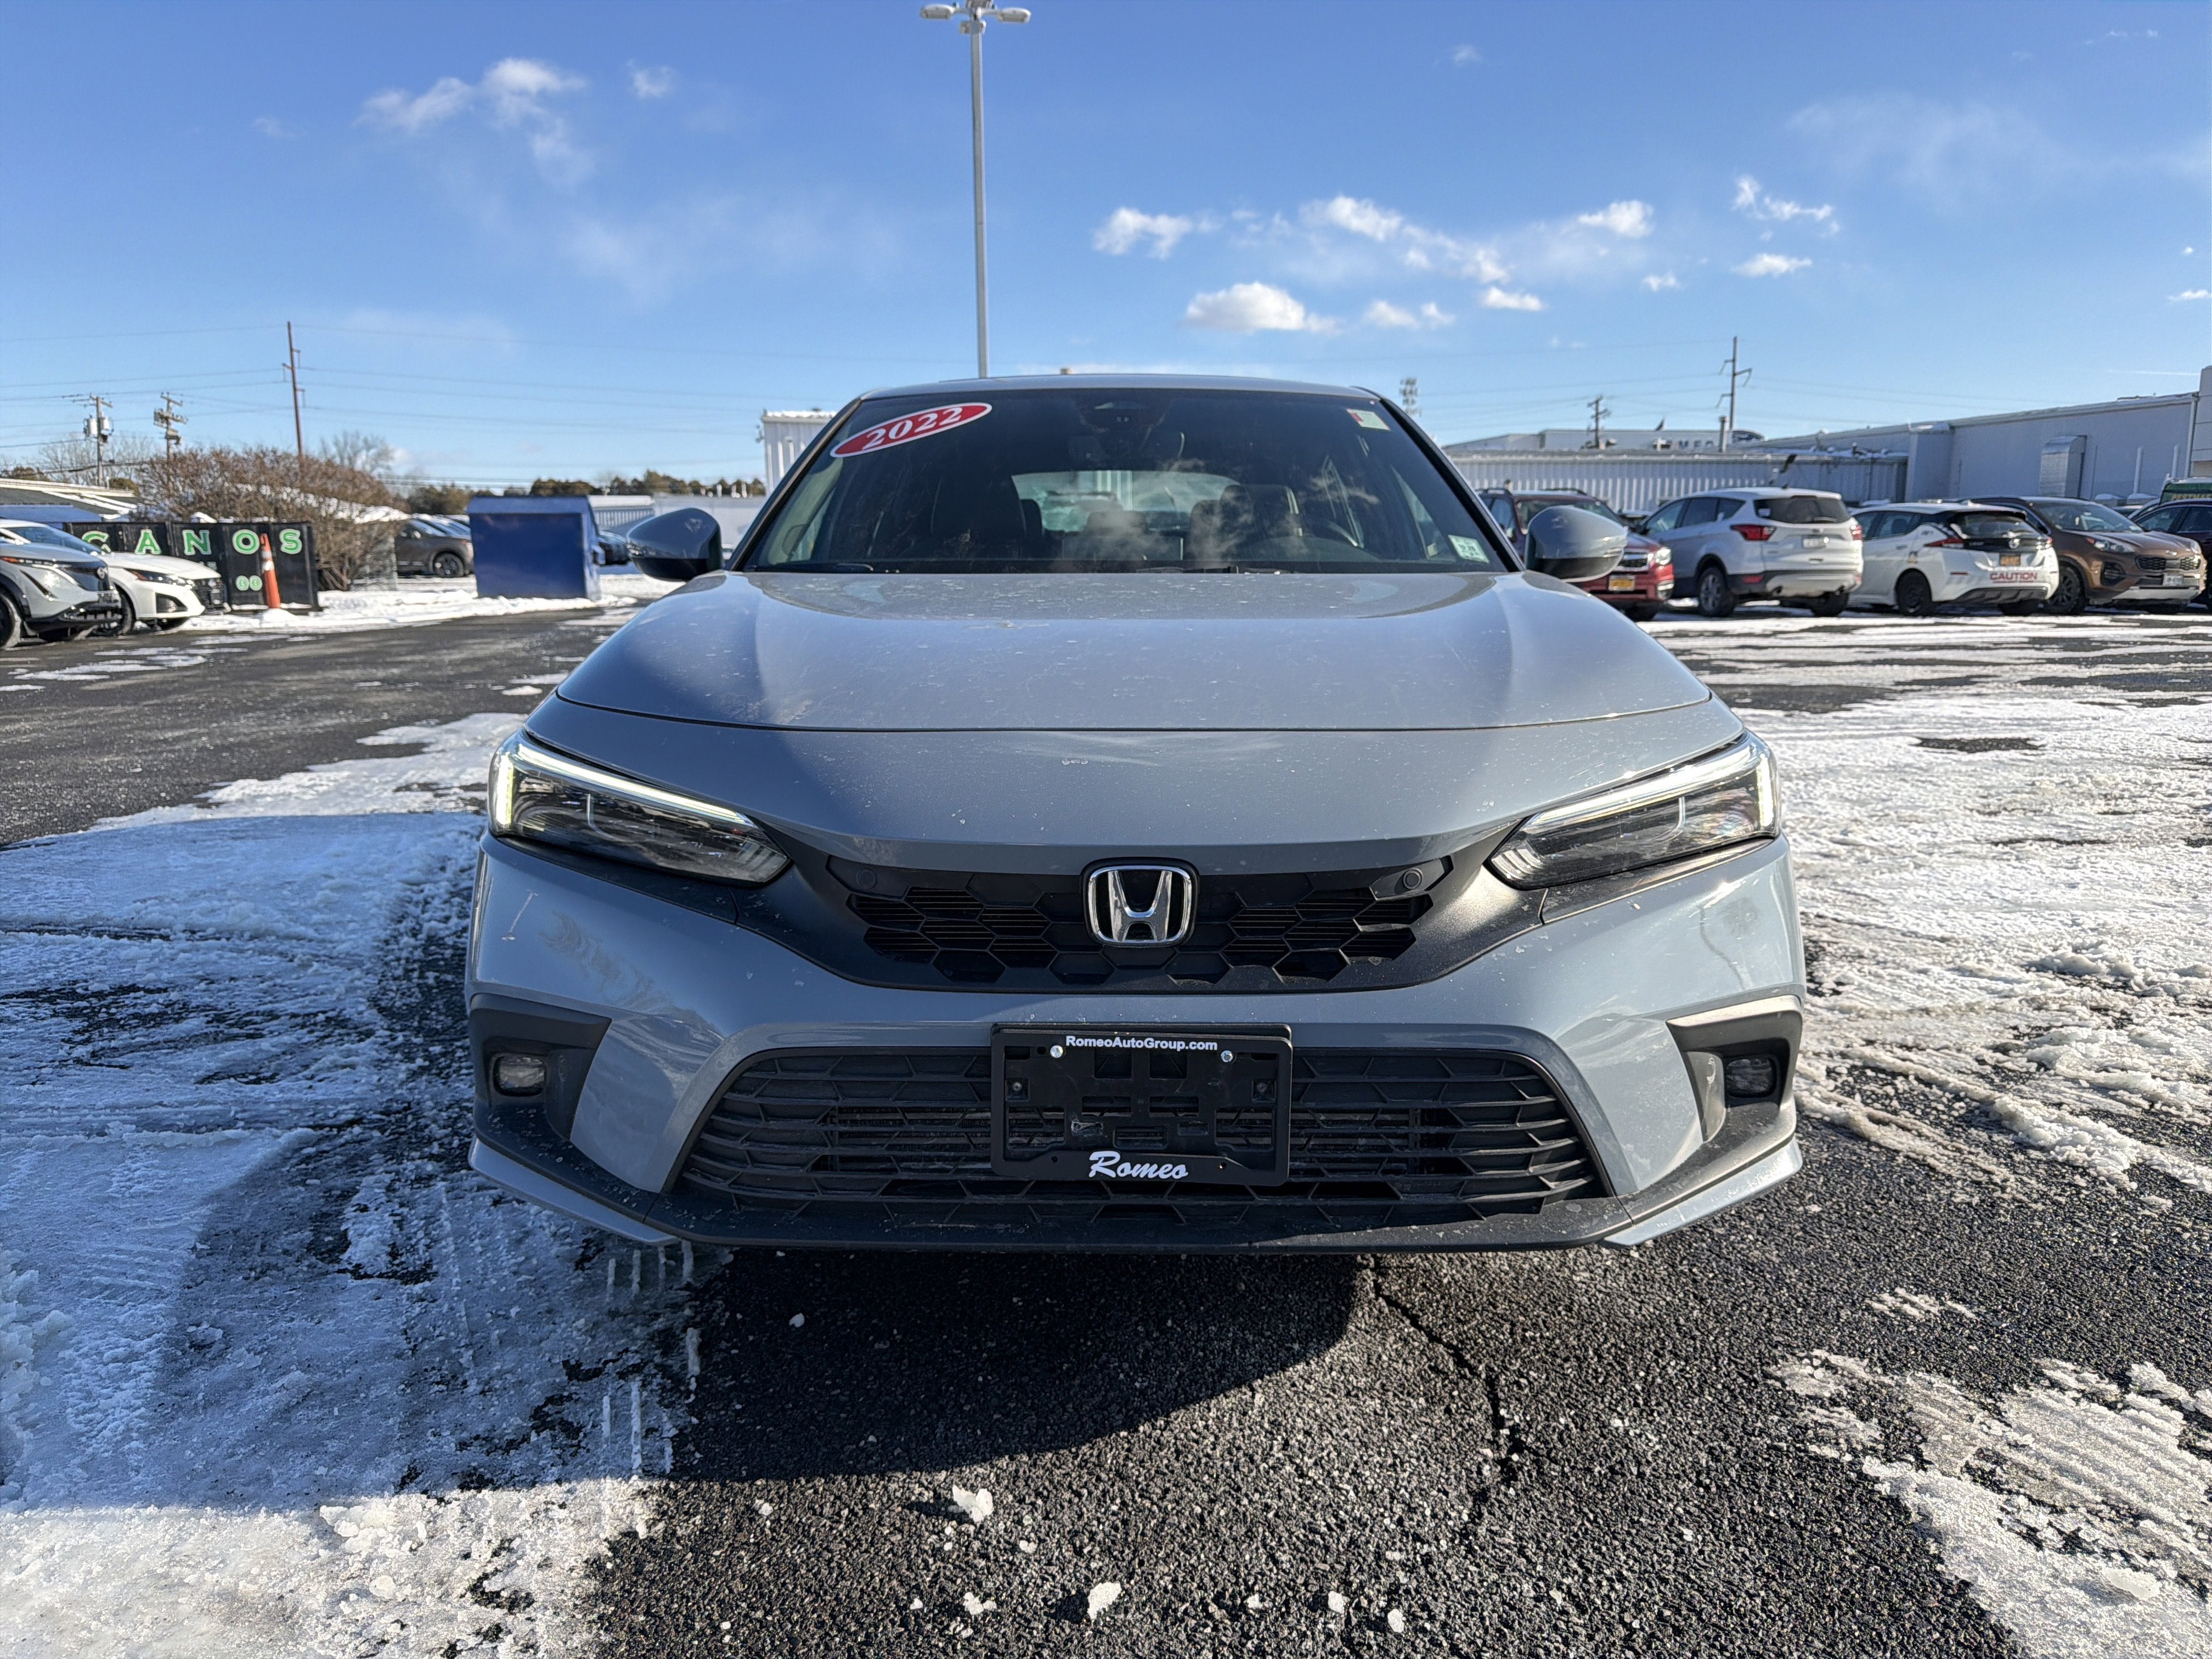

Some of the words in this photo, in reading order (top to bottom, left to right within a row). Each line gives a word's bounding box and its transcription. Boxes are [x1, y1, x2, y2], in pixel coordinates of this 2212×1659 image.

[862, 407, 963, 450] 2022
[1990, 572, 2038, 581] CAUTION
[1066, 1036, 1218, 1051] RomeoAutoGroup.com
[1088, 1150, 1188, 1179] Romeo
